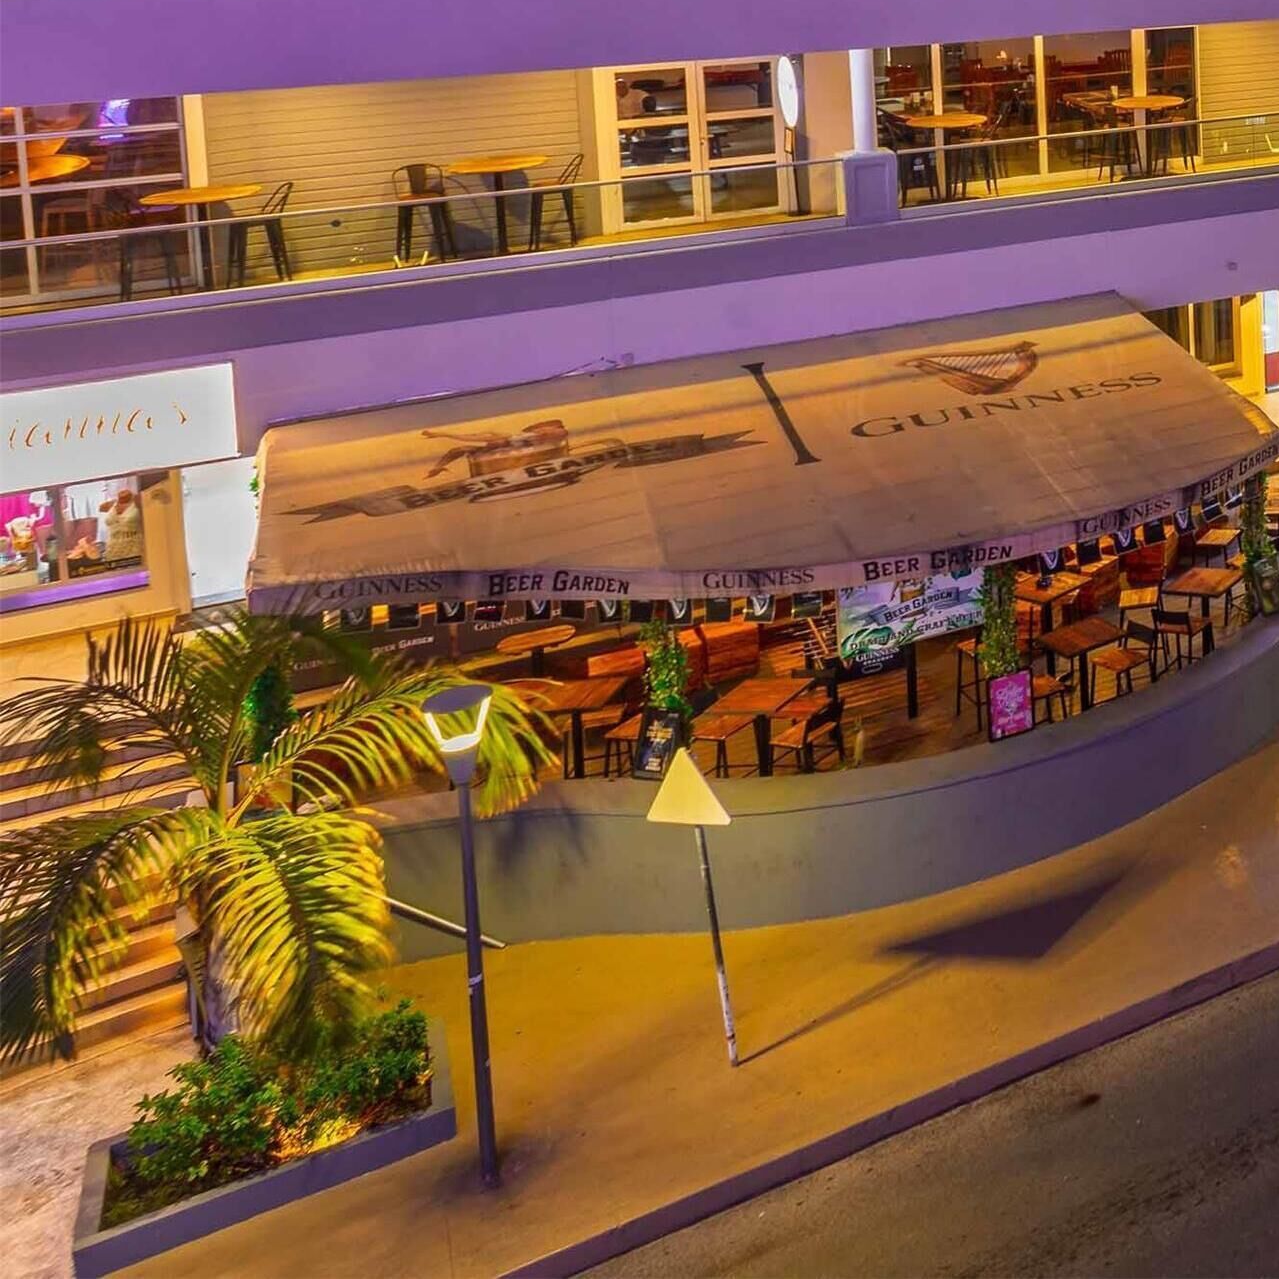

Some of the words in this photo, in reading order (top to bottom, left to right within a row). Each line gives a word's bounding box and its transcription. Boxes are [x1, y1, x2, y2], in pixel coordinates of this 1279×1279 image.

[851, 371, 1162, 437] GUINNESS
[399, 475, 511, 510] BEER
[1082, 497, 1172, 534] GUINNESS
[1201, 468, 1234, 497] BEER
[1239, 444, 1279, 474] GARDEN
[702, 568, 816, 590] GUINNESS
[862, 557, 920, 582] BEER
[929, 544, 1013, 570] GARDEN
[314, 577, 442, 600] GUINNESS
[487, 571, 543, 596] BEER
[551, 570, 630, 595] GARDEN
[884, 604, 912, 622] BEER
[911, 590, 953, 610] GARDEN
[855, 647, 900, 663] GUINNESS
